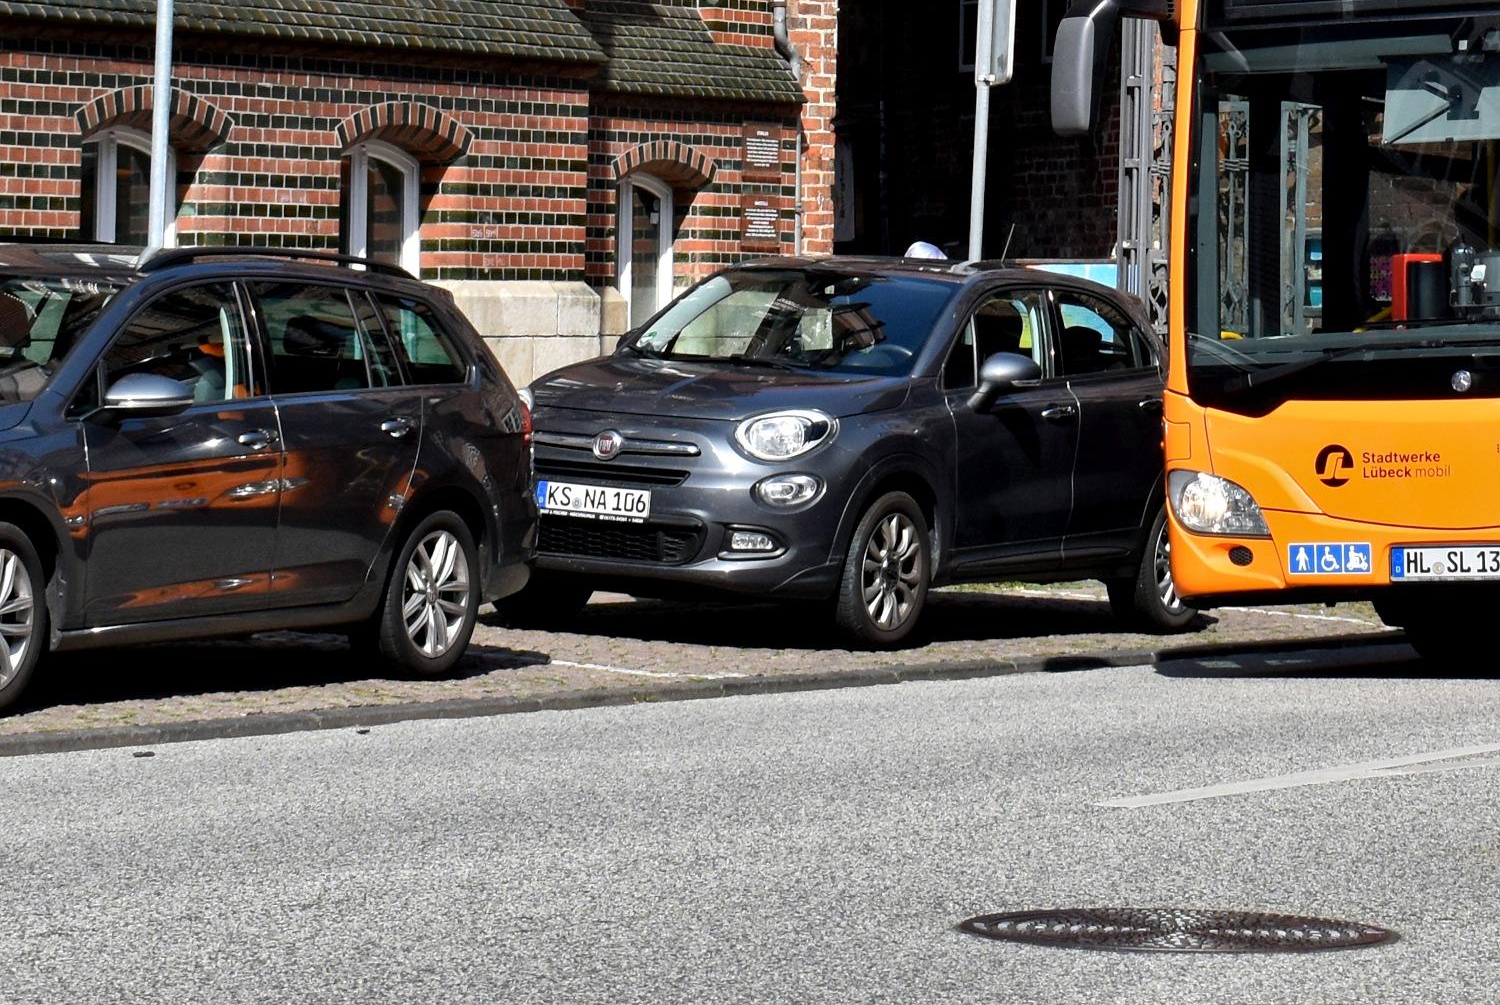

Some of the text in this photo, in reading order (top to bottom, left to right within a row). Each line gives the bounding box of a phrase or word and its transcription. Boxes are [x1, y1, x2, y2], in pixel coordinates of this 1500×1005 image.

[1362, 451, 1441, 464] Stadtwerke
[1362, 463, 1451, 479] Lübeck mobil
[548, 486, 646, 513] KS NA 106
[1406, 551, 1431, 574] HL
[1447, 551, 1471, 573] SL
